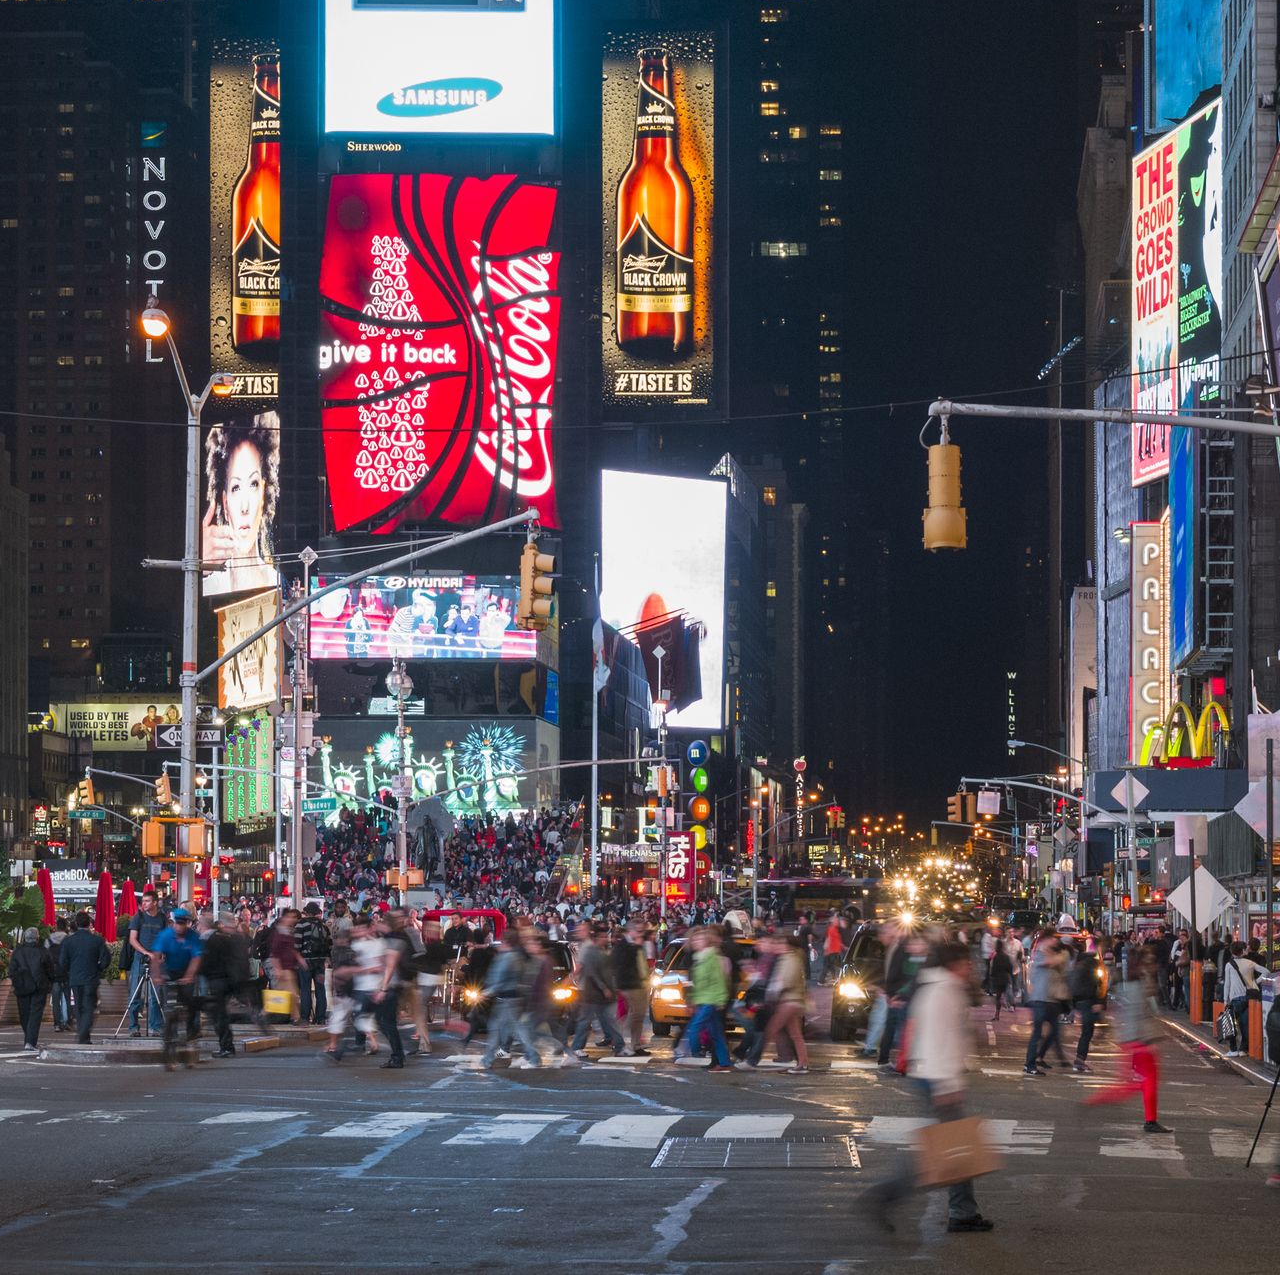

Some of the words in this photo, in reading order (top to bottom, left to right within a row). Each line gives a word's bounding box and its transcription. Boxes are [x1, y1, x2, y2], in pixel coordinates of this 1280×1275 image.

[392, 88, 488, 107] SAMSUNG
[347, 141, 402, 153] SHERWOOD
[1135, 142, 1174, 211] THE
[1135, 196, 1174, 242] CROWD
[142, 156, 167, 364] NOVOTL
[1135, 229, 1174, 277] GOES
[239, 276, 266, 290] BLACK
[624, 272, 651, 286] BLACK
[652, 272, 687, 287] CROWN
[1135, 271, 1175, 322] WILD!
[318, 340, 371, 369] give
[381, 342, 398, 364] it
[403, 342, 457, 364] back
[232, 376, 279, 394] #TAST
[614, 373, 673, 392] #TASTE
[677, 373, 692, 392] IS
[408, 576, 463, 589] HYUNDAI
[1141, 540, 1162, 738] PALACE
[69, 711, 95, 722] USED
[97, 711, 109, 722] BY
[111, 711, 129, 722] THE
[69, 721, 106, 730] WORLD'S
[107, 721, 129, 730] BEST
[303, 801, 332, 811] Broadway
[668, 834, 690, 880] tkts
